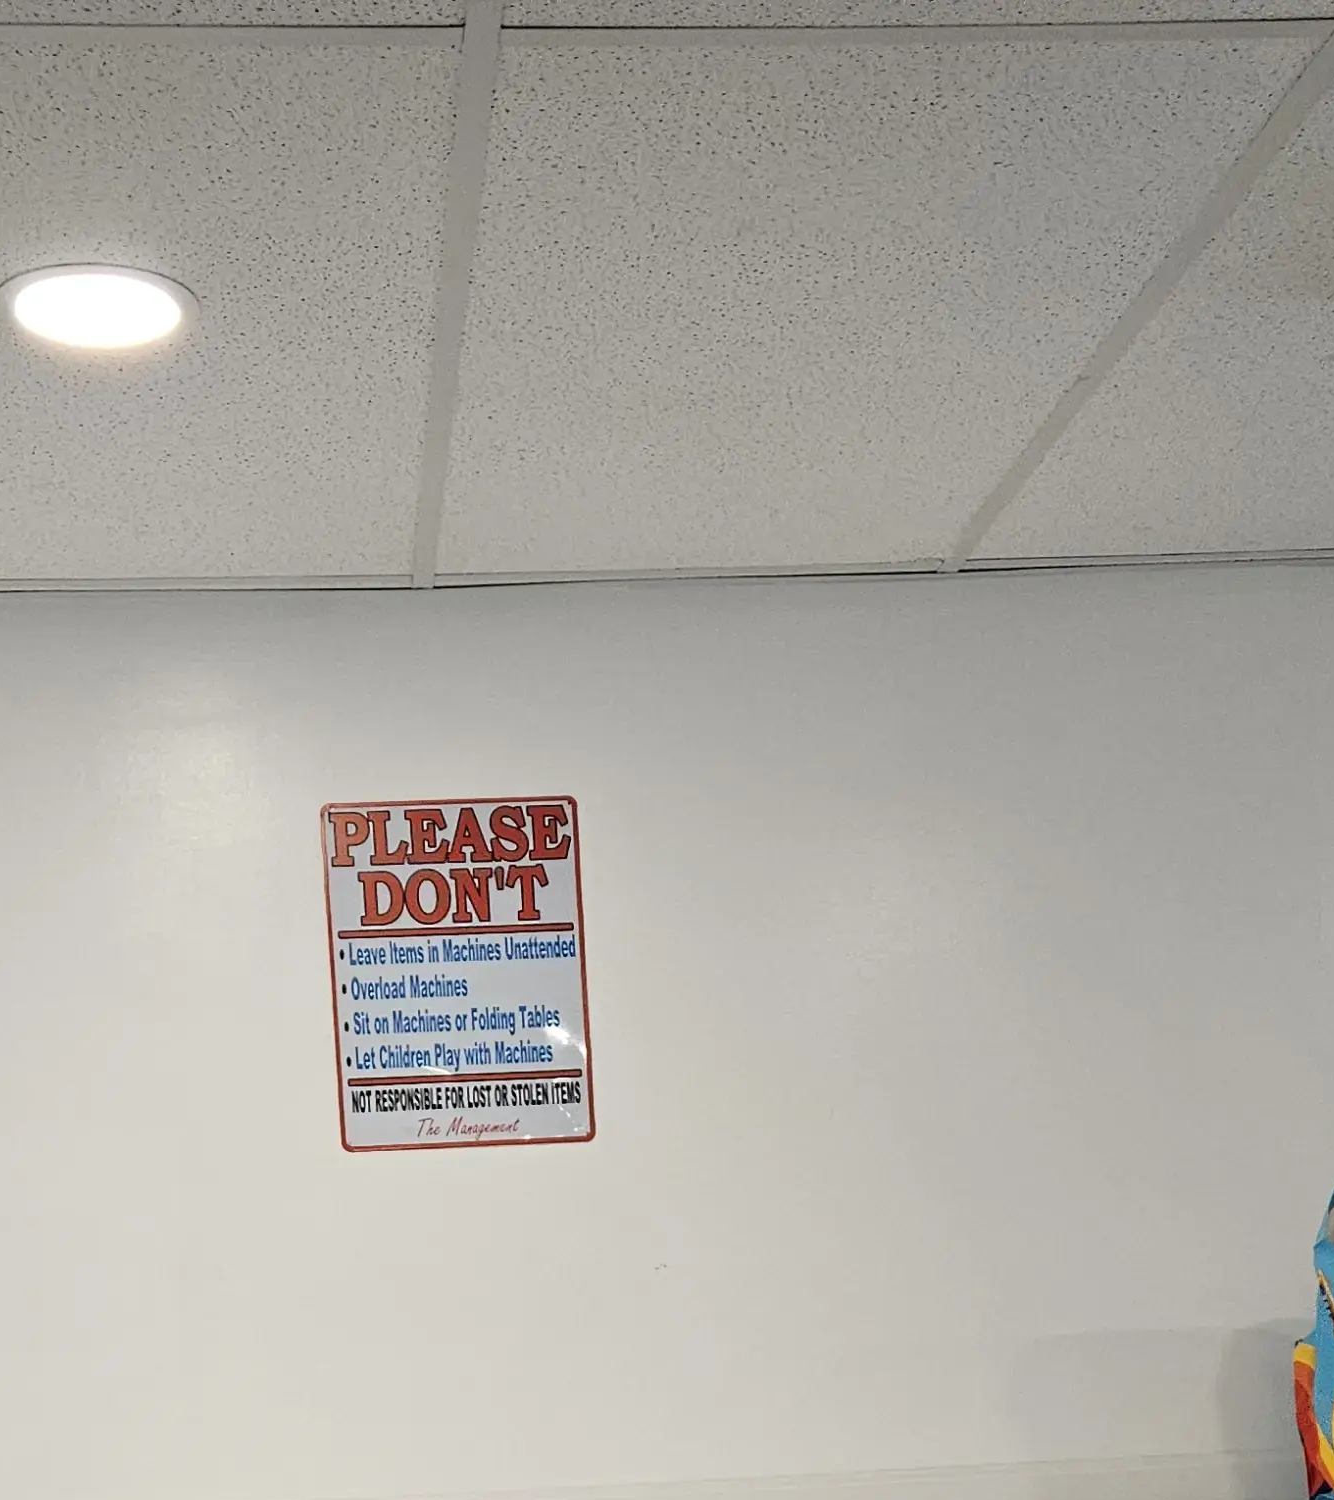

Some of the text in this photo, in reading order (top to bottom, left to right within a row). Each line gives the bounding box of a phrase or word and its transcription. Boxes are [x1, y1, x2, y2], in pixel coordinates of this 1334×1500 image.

[329, 805, 571, 867] PLEASE
[358, 864, 548, 926] DON'T
[348, 934, 575, 966] Leave Items in Machines Unattended
[351, 973, 467, 1000] Overload Machines
[354, 1005, 559, 1035] Sit on Machines or Folding Tables
[356, 1040, 553, 1071] Let Children Play with Machines
[352, 1082, 581, 1113] NOT RESPONSIBLE FOR LOST OR STOLEN ITEMS
[417, 1116, 519, 1141] The Management
